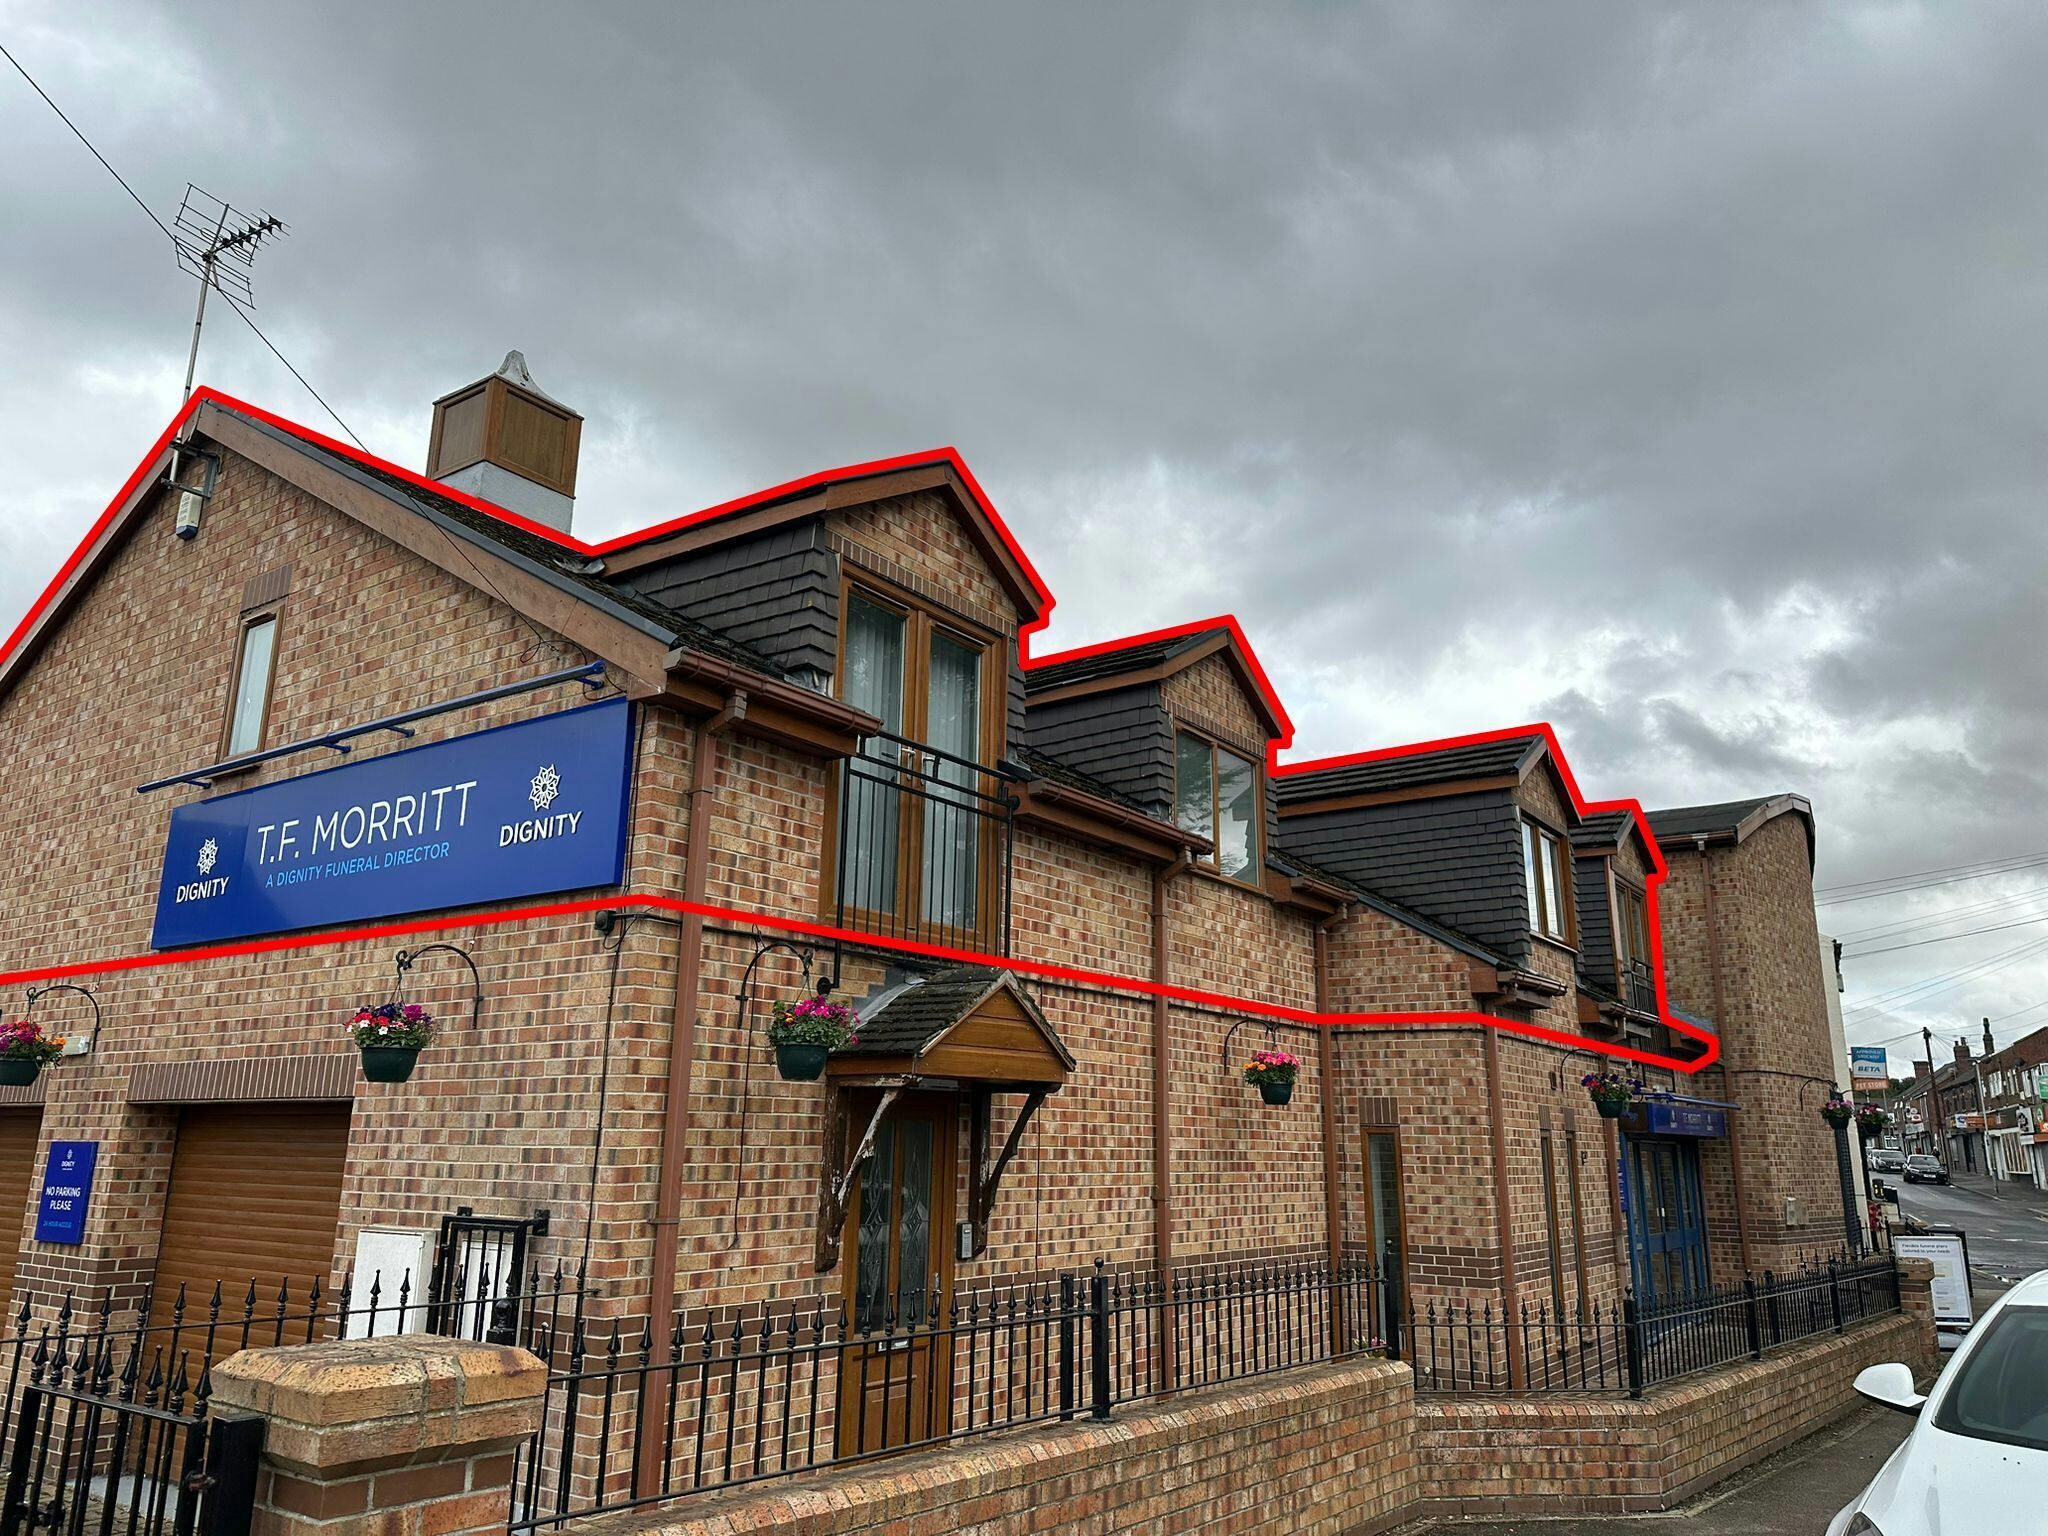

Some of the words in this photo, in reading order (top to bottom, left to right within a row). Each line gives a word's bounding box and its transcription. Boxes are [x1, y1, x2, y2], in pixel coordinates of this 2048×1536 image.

[257, 820, 300, 865] T.F.
[311, 780, 478, 854] MORRITT
[499, 810, 583, 847] DIGNITY
[265, 873, 275, 888] A
[276, 865, 323, 886] DIGNITY
[325, 854, 380, 877] FUNERAL
[384, 841, 450, 867] DIRECTOR
[175, 876, 230, 904] DIGNITY
[46, 1187, 55, 1196] NO
[55, 1186, 81, 1197] PARKING
[49, 1200, 72, 1211] PLEASE
